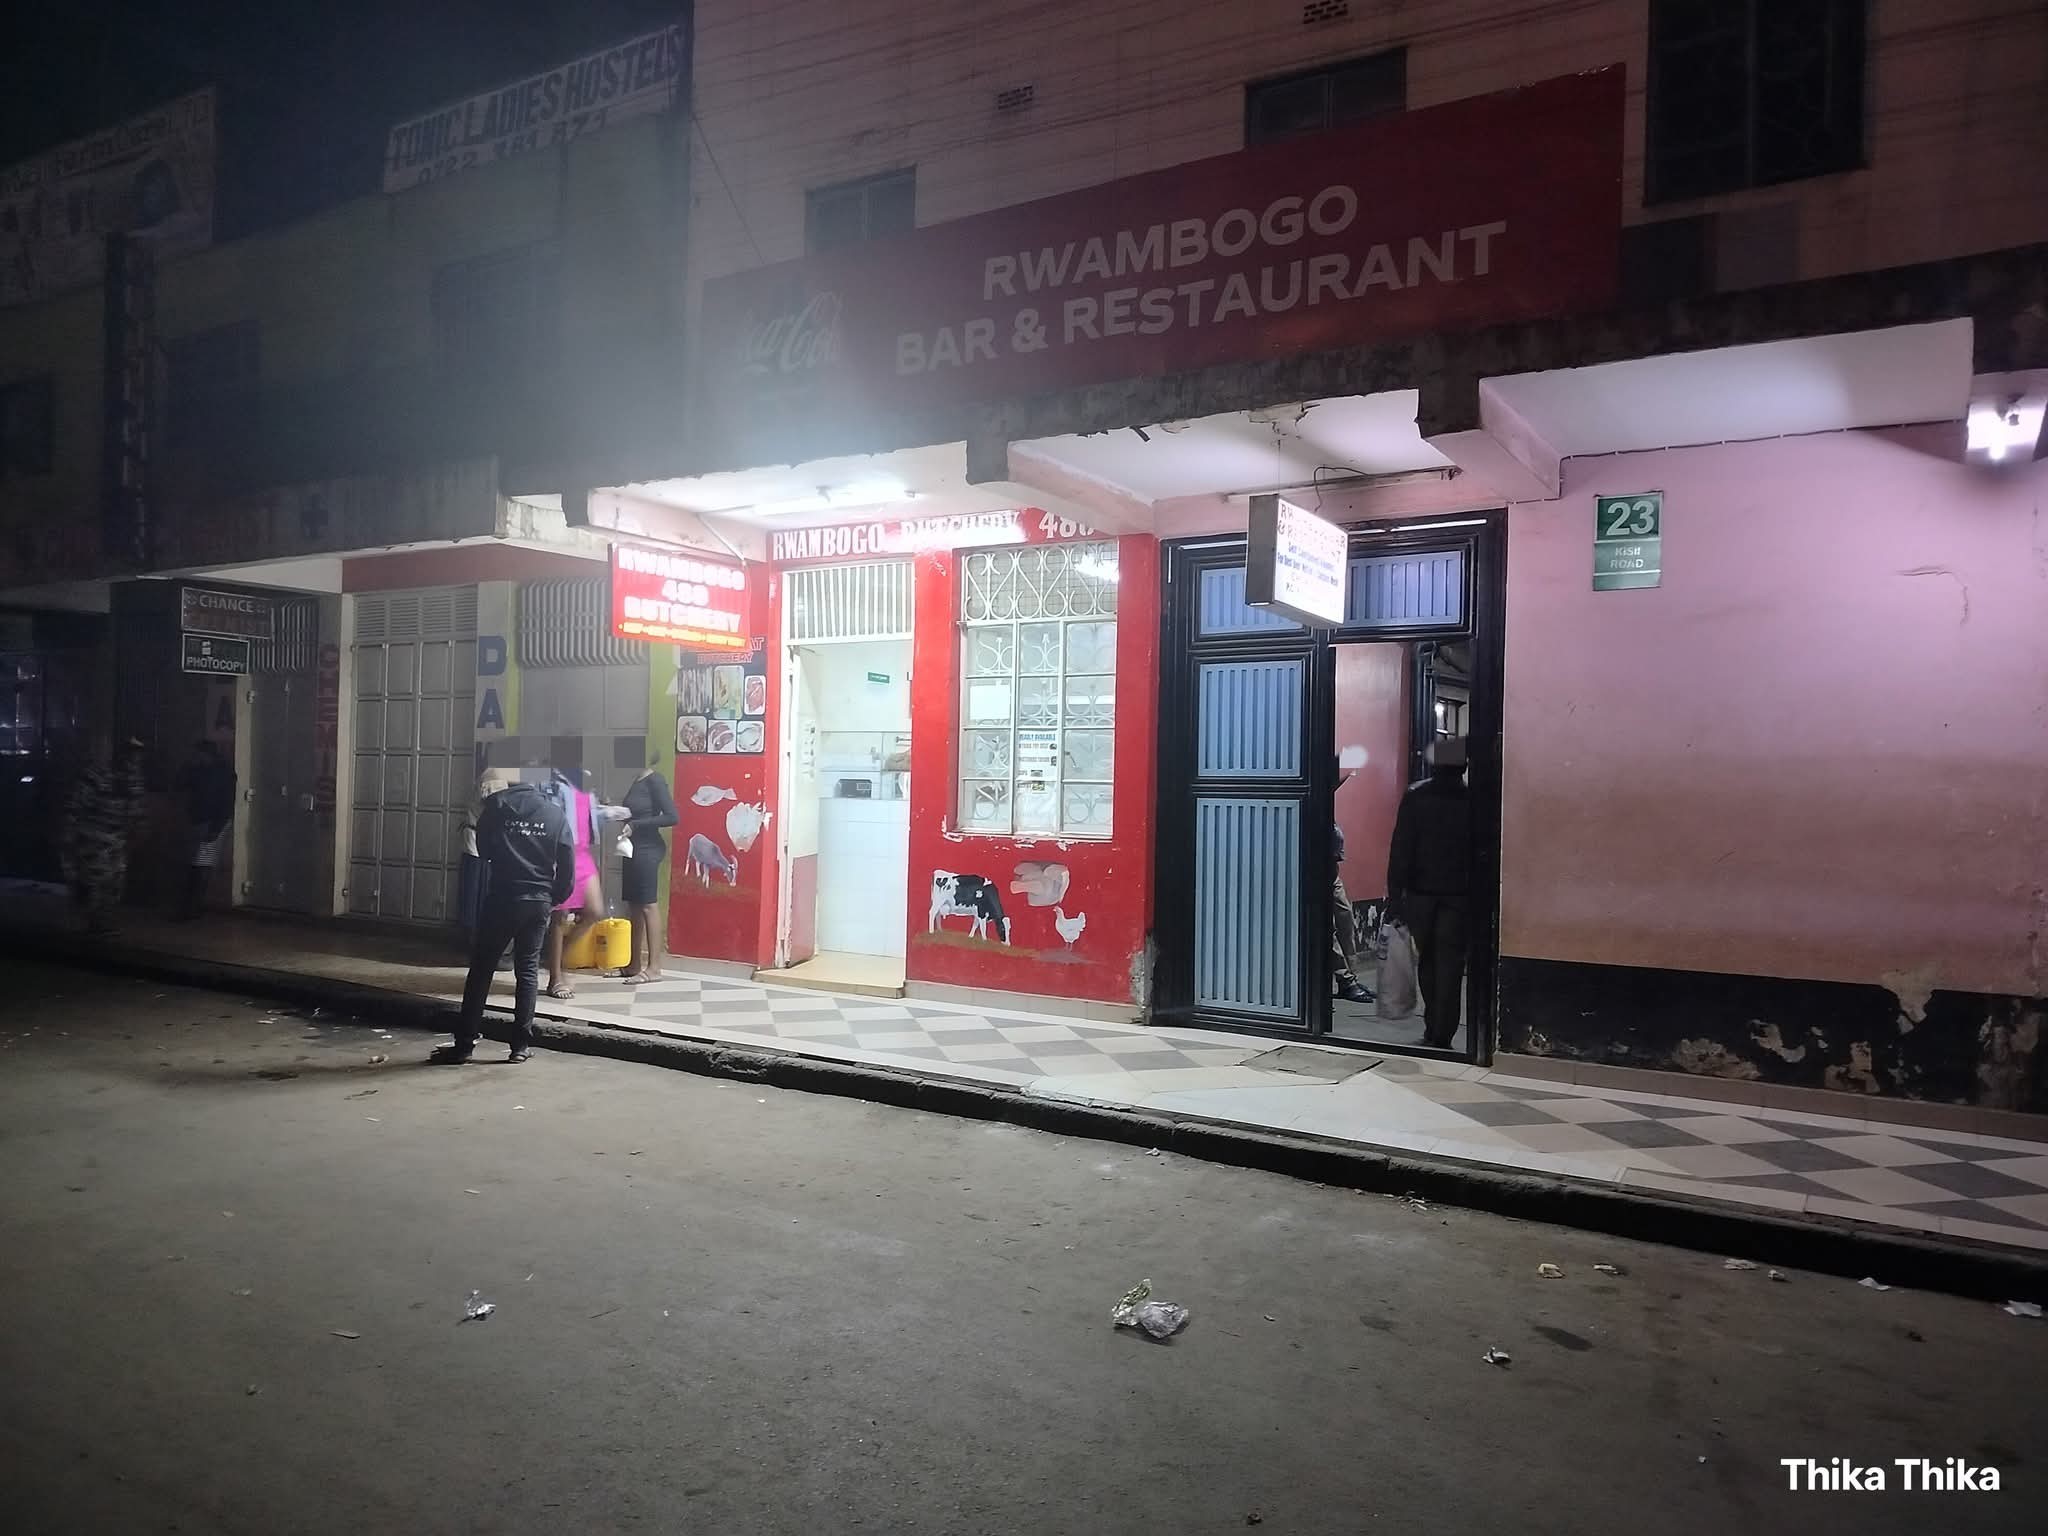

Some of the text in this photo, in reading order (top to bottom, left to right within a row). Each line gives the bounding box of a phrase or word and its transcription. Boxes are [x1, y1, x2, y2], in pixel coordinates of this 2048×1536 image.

[983, 185, 1358, 301] RWAMBOGO
[895, 220, 1507, 376] BAR & RESTAURANT
[1606, 500, 1655, 536] 23
[773, 523, 883, 561] RWAMBOGO
[1610, 559, 1644, 569] ROAD
[199, 594, 256, 613] CHANCE
